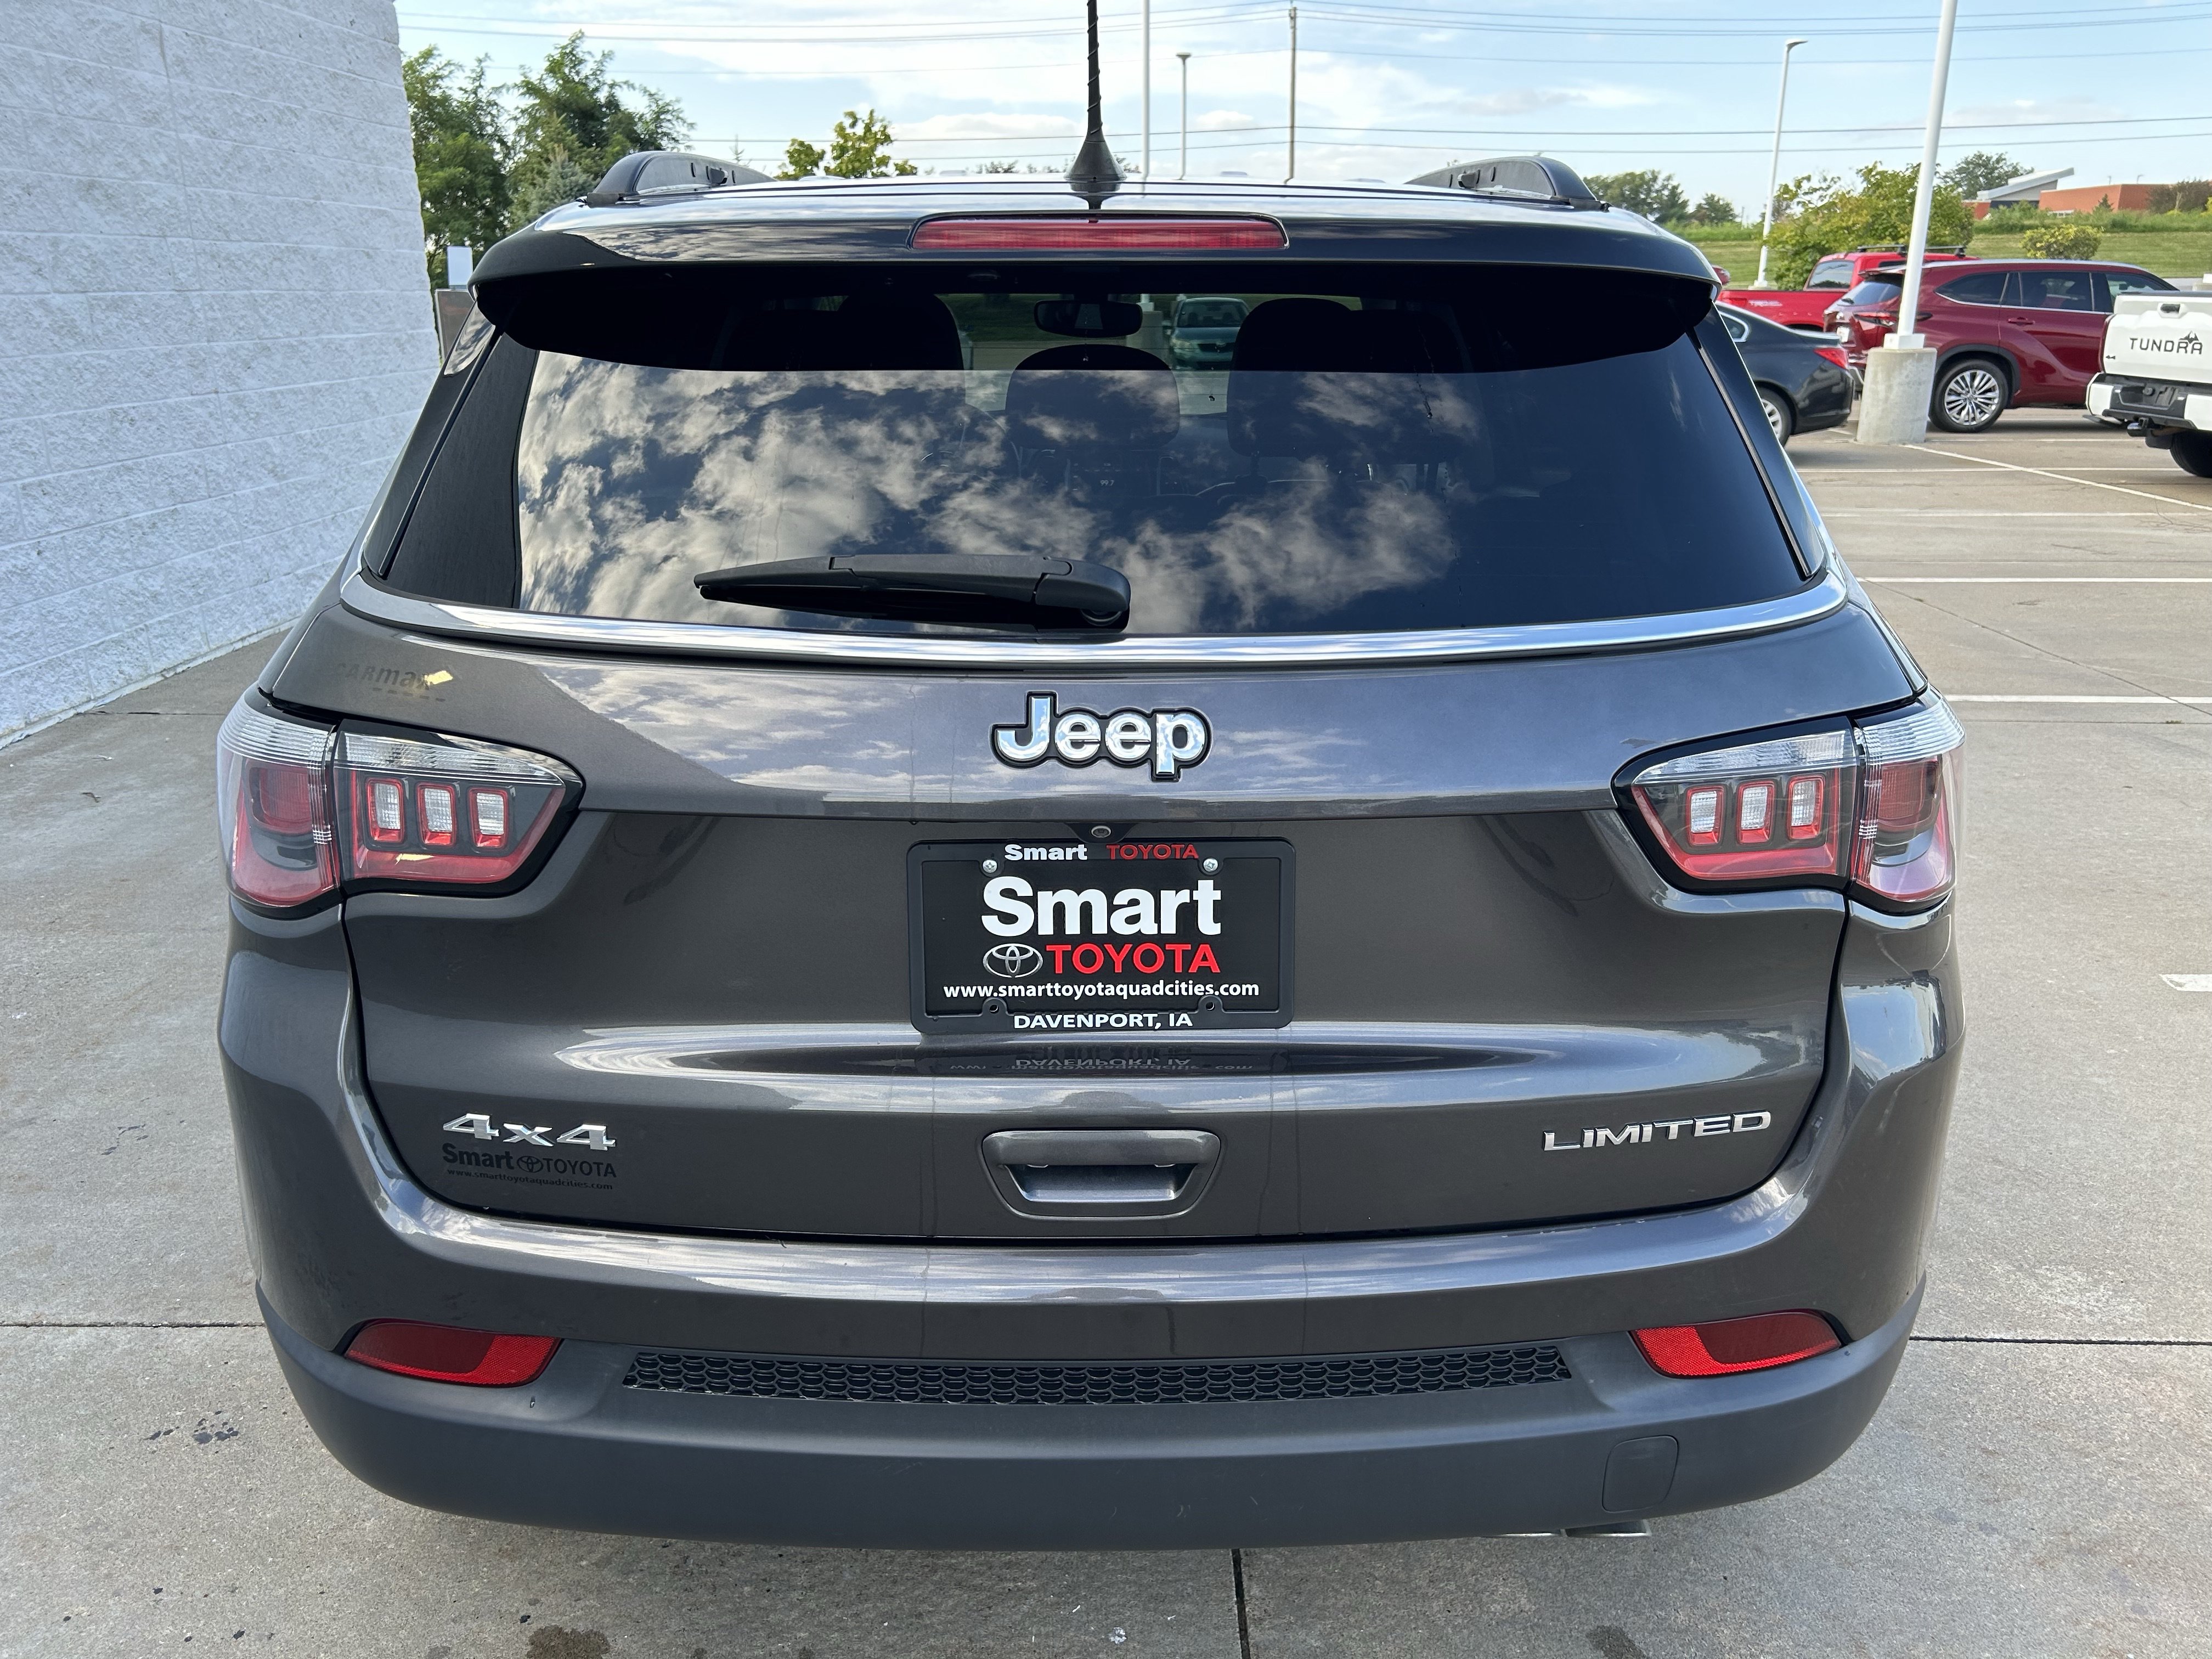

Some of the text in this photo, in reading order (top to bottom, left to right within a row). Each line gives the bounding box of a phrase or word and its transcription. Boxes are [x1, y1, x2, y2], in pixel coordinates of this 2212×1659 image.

[2129, 337, 2203, 355] TUNDRA
[996, 696, 1206, 776] Jeep
[1004, 843, 1199, 861] Smart TOYOTA
[981, 876, 1222, 937] Smart
[1046, 942, 1221, 974] TOYOTA
[943, 980, 1259, 1001] www.smarttoyotaquadcities.com
[1013, 1013, 1193, 1030] DAVENPORT, IA
[442, 1112, 617, 1151] 4x4
[1542, 1110, 1771, 1151] LIMITED
[442, 1142, 617, 1178] Smart TOYOTA
[447, 1167, 613, 1190] www.smarttoyotaquadcities.com
